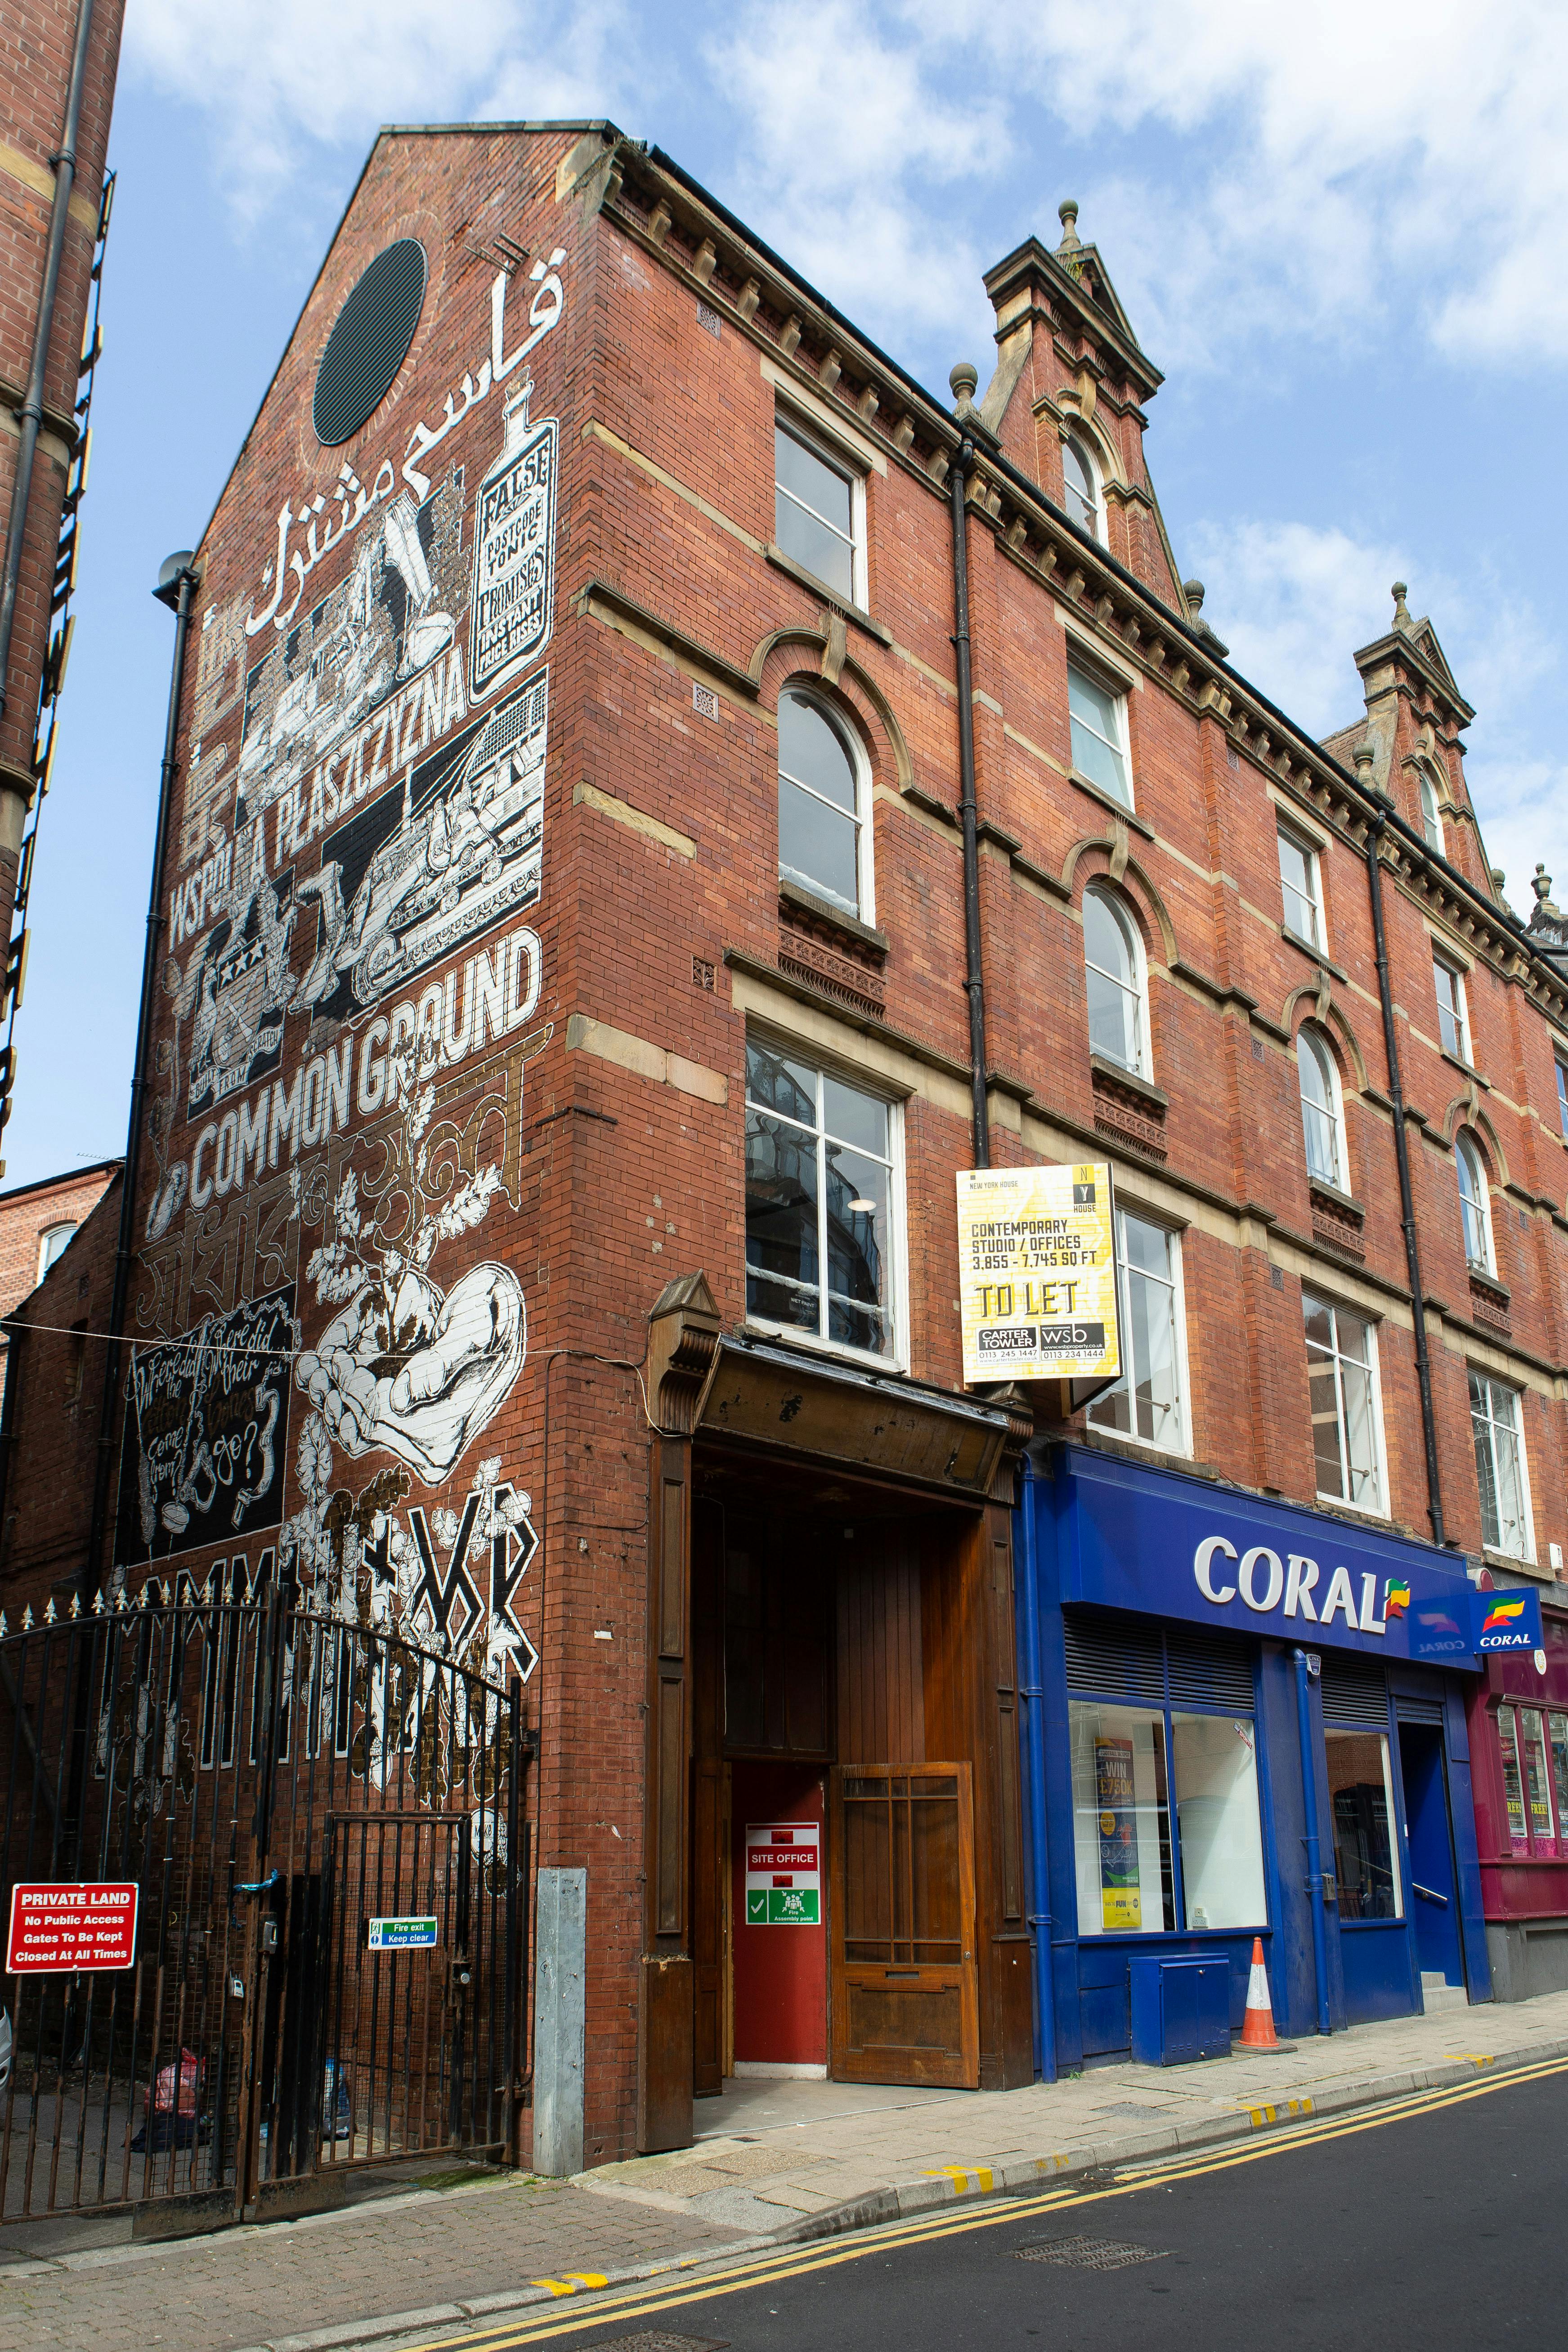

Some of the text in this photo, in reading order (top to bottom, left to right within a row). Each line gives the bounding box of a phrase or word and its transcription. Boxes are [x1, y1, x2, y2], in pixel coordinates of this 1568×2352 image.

[483, 440, 549, 543] FALSE
[488, 497, 542, 561] POSTCODE
[488, 522, 538, 576] TONIC
[479, 543, 545, 627] PROMISES
[481, 590, 541, 653] INSTANT
[479, 610, 541, 673] PRICE RISES
[274, 644, 468, 869] PŁASZCZYZNA
[189, 925, 542, 1211] COMMON GROUND
[219, 1064, 248, 1095] FROM
[1080, 1167, 1087, 1181] N
[1080, 1186, 1088, 1201] Y
[1074, 1205, 1097, 1213] HOUSE
[972, 1219, 1067, 1237] CONTEMPORARY
[972, 1235, 1080, 1254] STUDIO / OFFICES
[973, 1255, 1008, 1271] 3,855
[1022, 1253, 1057, 1268] 7,745
[1062, 1252, 1077, 1266] SQ
[1082, 1250, 1097, 1264] FT
[974, 1280, 1080, 1317] TO LET
[982, 1329, 1029, 1340] CARTER
[983, 1338, 1033, 1348] TOWLER
[1042, 1323, 1087, 1344] wsb
[205, 1315, 279, 1388] Where did
[136, 1351, 179, 1415] Where
[223, 1351, 260, 1395] their
[167, 1373, 182, 1399] the
[148, 1426, 184, 1460] come
[213, 1420, 258, 1485] go?
[150, 1448, 183, 1504] from?
[1194, 1536, 1386, 1634] CORAL
[1480, 1634, 1531, 1647] CORAL
[1106, 1762, 1126, 1778] WIN
[1100, 1778, 1133, 1795] £750K
[1507, 1802, 1521, 1813] REE!
[1531, 1803, 1548, 1814] FREE!
[752, 1854, 814, 1863] SITE OFFICE
[21, 1893, 130, 1905] PRIVATE LAND
[25, 1915, 124, 1925] No Public Access
[394, 1923, 425, 1932] Fire exit
[24, 1932, 123, 1944] Gates To Be Kept
[388, 1934, 429, 1944] Keep clear
[15, 1949, 127, 1962] Closed At All Times
